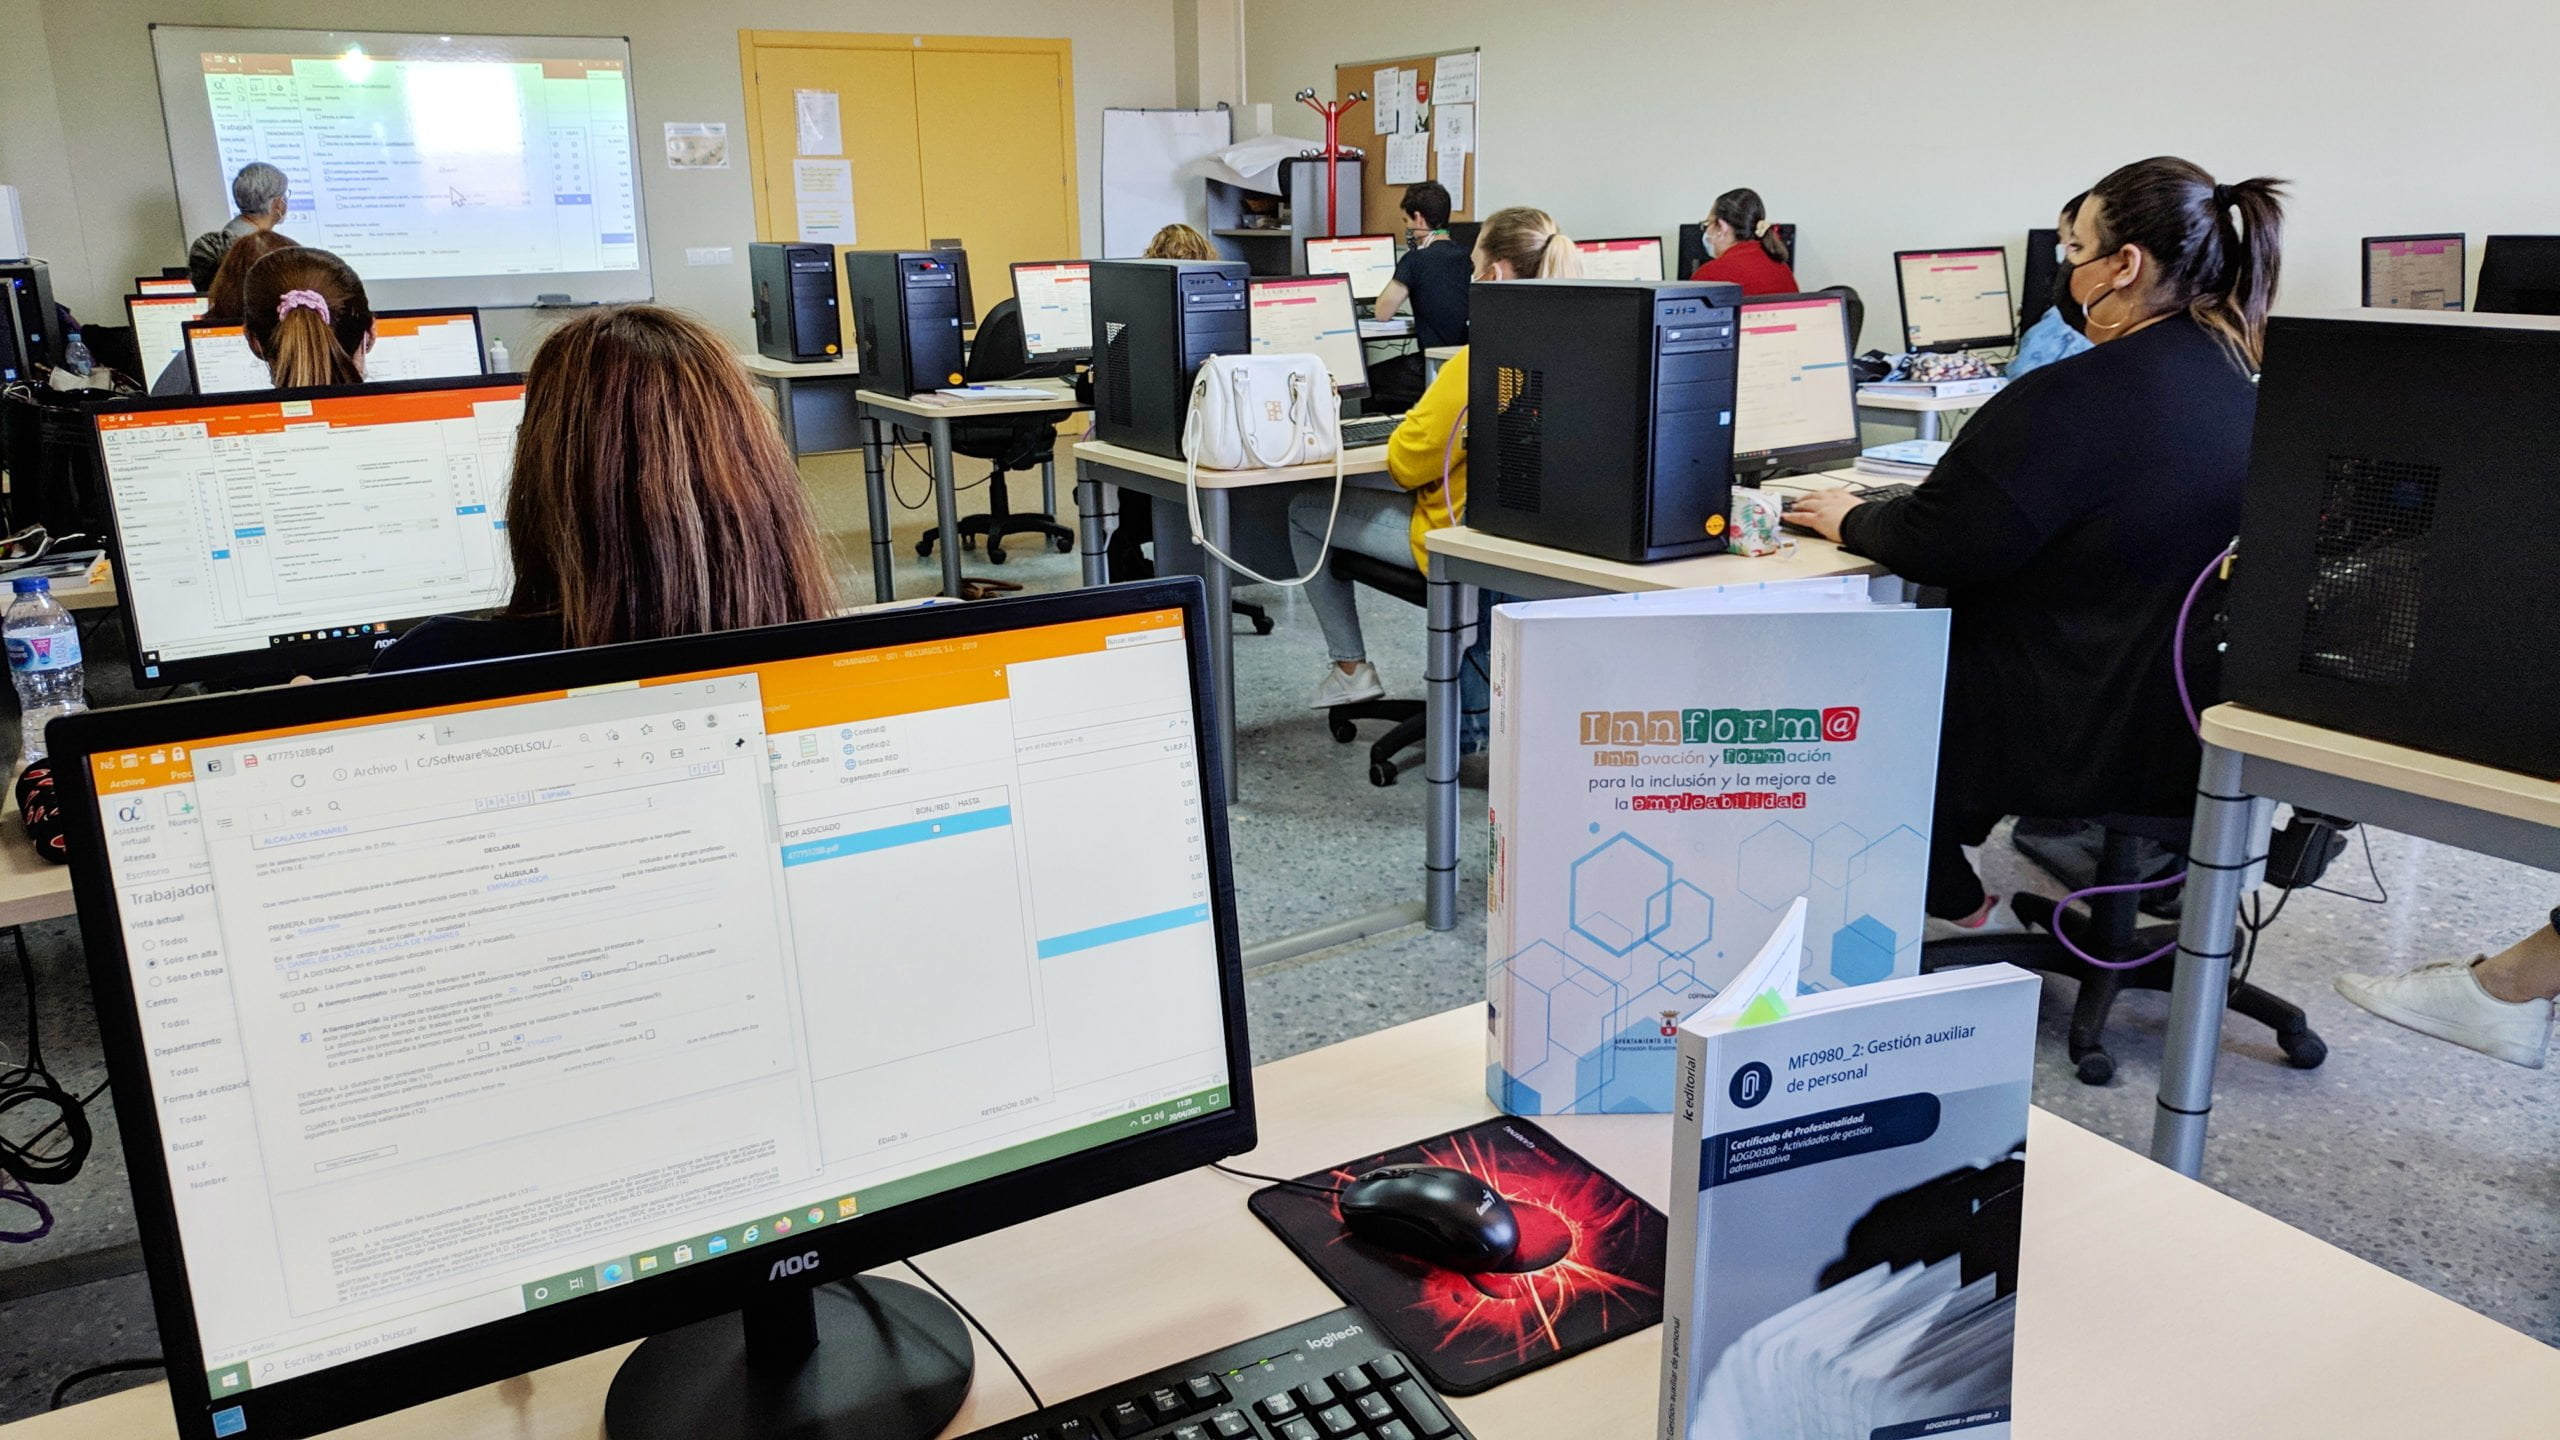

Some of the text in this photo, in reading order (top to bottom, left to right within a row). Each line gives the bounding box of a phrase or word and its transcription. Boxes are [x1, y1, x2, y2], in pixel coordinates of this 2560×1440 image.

[1581, 708, 1858, 745] Innform@
[791, 754, 829, 768] Certificado
[857, 752, 898, 767] Sistema RED
[1179, 760, 1192, 769] 0,00
[1594, 749, 1831, 767] Innovación y formación
[354, 763, 398, 779] Archivo
[839, 765, 909, 785] Organismos oficiales
[1180, 779, 1193, 788] 0,00
[1589, 772, 1836, 792] para la inclusión y la mejora de
[1615, 793, 1806, 812] la empleabilidad
[290, 807, 305, 816] de
[784, 829, 800, 839] PDF
[801, 822, 841, 836] ASOCIADO
[957, 796, 980, 807] HASTA
[168, 816, 198, 828] Nuevo
[123, 851, 156, 863] Atenea
[130, 914, 185, 930] Vista actual
[160, 936, 188, 948] Todos
[163, 950, 218, 966] Solo en alta
[166, 966, 224, 984] Solo en baja
[145, 996, 179, 1009] Centro
[161, 1018, 190, 1030] Todos
[154, 1037, 222, 1057] Departamento
[1788, 1025, 1976, 1071] MF0980_2: Gestión auxiliar
[170, 1066, 199, 1078] Todos
[1787, 1064, 1868, 1093] de personal
[1685, 1056, 1697, 1106] editorial
[163, 1091, 194, 1105] Forma
[196, 1088, 208, 1098] de
[1731, 1113, 1865, 1151] Certificado de Profesionalidad
[1782, 1134, 1829, 1151] Actividades
[1830, 1131, 1841, 1141] de
[1842, 1125, 1872, 1139] gestión
[172, 1139, 204, 1152] Buscar
[1729, 1153, 1790, 1174] administrativa
[769, 1251, 820, 1281] AOC
[1306, 1324, 1364, 1350] logitech
[283, 1350, 324, 1370] Escribe
[353, 1336, 377, 1350] para
[381, 1323, 417, 1342] buscar
[1671, 1357, 1678, 1369] de
